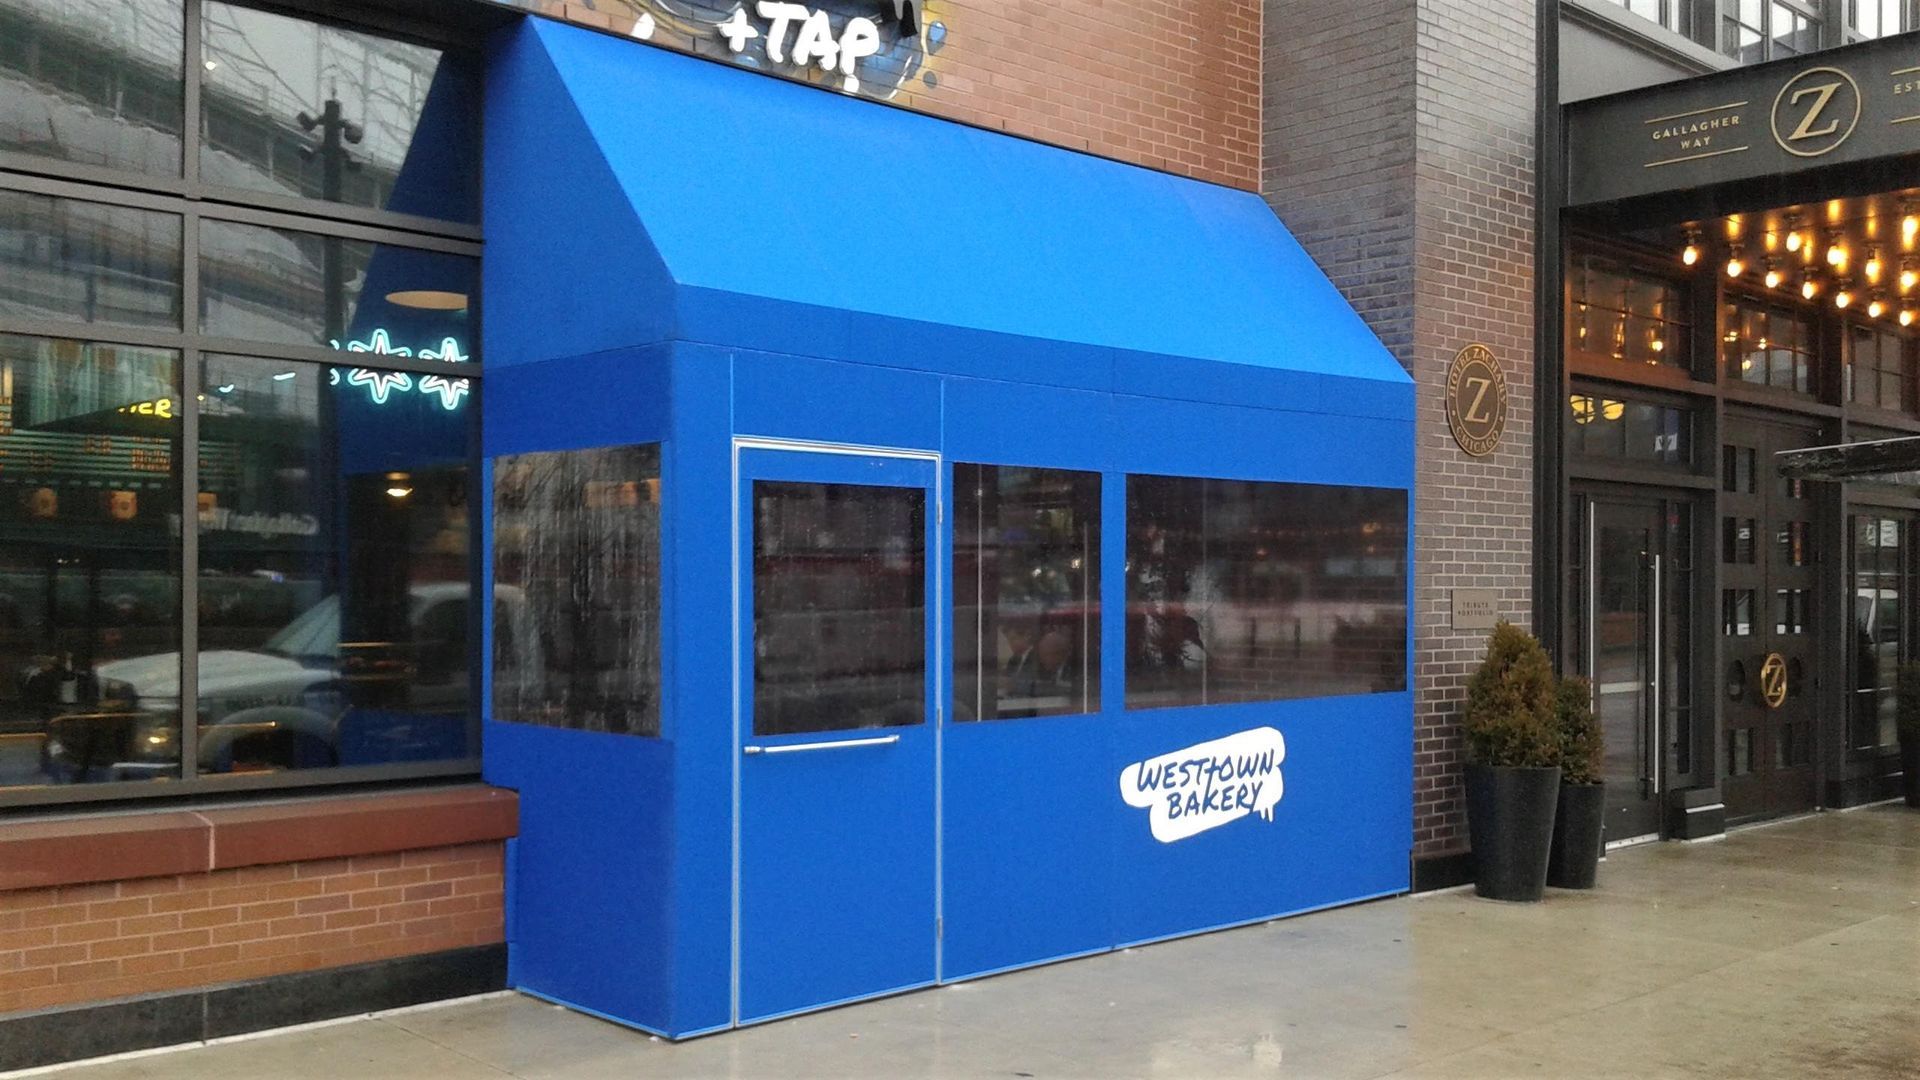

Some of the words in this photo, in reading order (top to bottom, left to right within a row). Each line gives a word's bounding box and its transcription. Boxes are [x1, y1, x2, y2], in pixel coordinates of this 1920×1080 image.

[1652, 115, 1741, 141] GALLAGHER
[1788, 82, 1843, 141] Z
[1680, 135, 1712, 150] WAY
[1448, 350, 1472, 398] HOTEL
[1464, 376, 1492, 424] Z
[1456, 426, 1500, 453] CHICAGO
[1166, 780, 1264, 820] BAKERY
